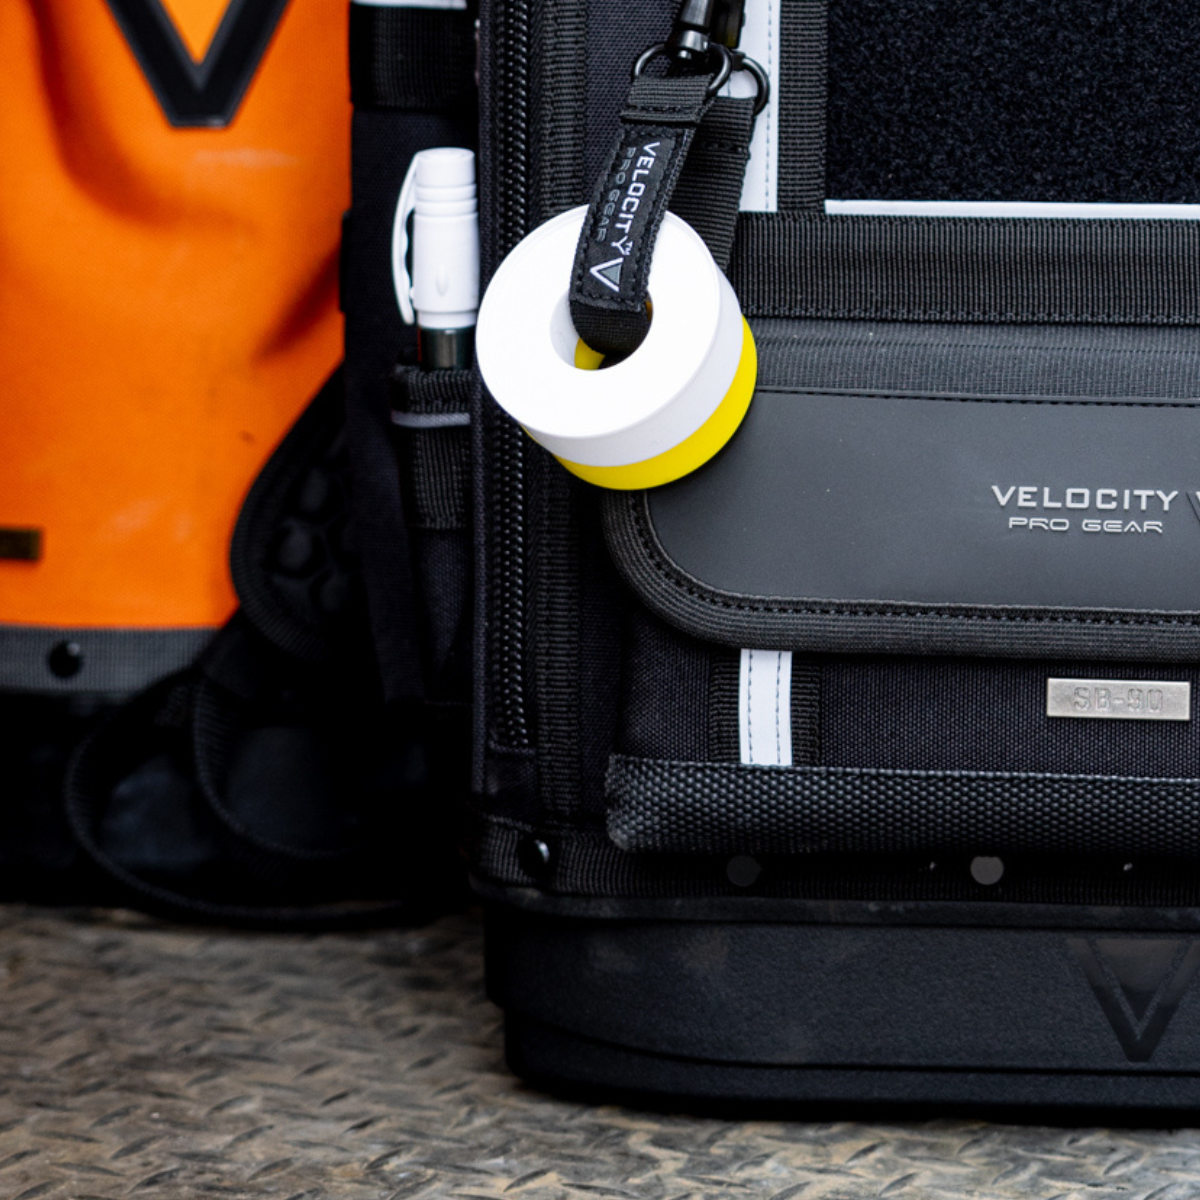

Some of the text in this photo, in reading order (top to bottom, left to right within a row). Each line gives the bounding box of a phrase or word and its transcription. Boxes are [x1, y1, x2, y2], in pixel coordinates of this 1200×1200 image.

[597, 147, 637, 243] PRO GEAR
[991, 485, 1178, 511] VELOCITY
[1008, 517, 1163, 534] PRO GEAR
